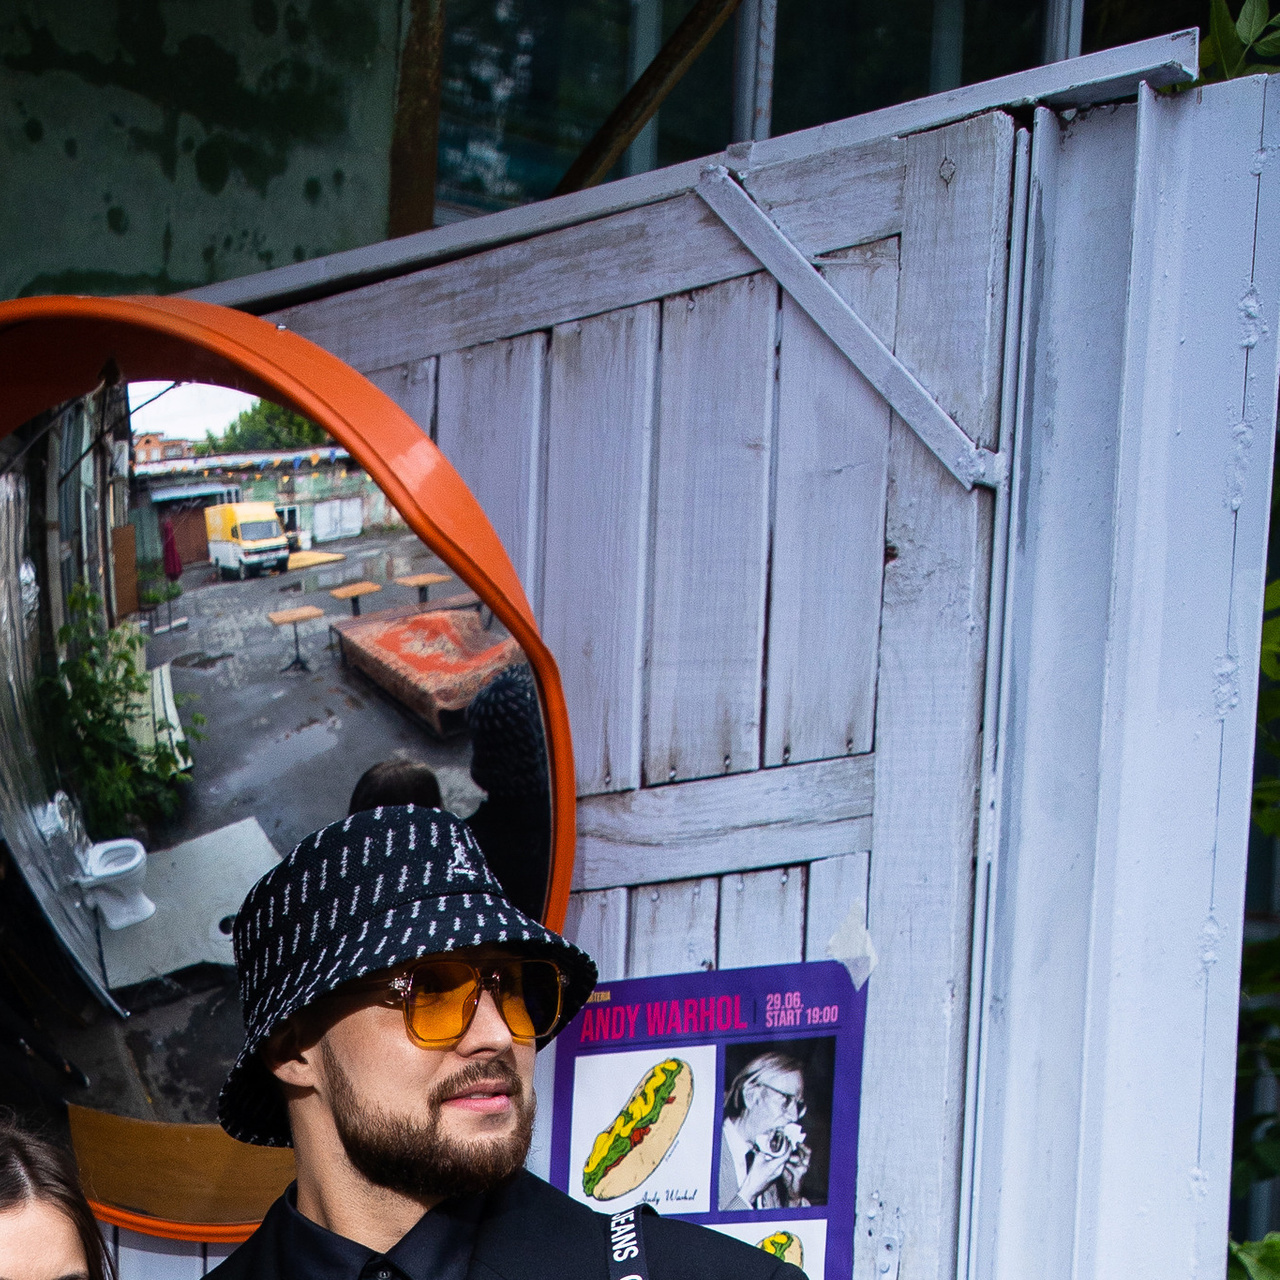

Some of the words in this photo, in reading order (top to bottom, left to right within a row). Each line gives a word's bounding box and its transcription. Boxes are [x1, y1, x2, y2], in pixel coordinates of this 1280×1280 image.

[766, 991, 804, 1010] 29.06.
[580, 1003, 641, 1043] ANDY
[646, 994, 748, 1037] WARHOL
[765, 1009, 803, 1028] START
[806, 1005, 839, 1025] 19:00
